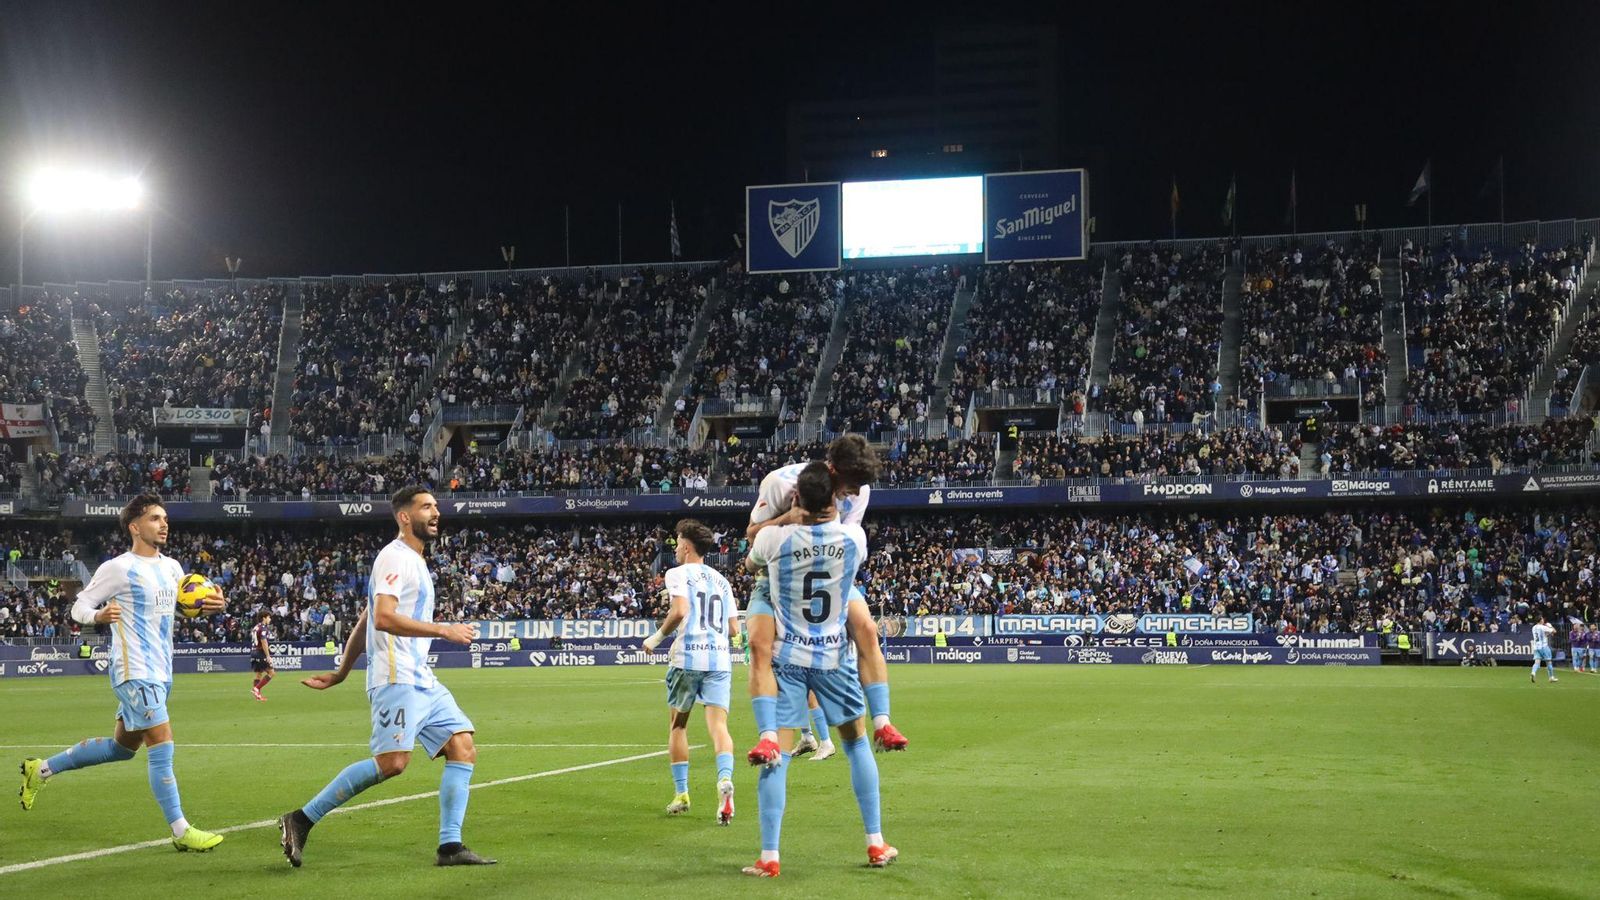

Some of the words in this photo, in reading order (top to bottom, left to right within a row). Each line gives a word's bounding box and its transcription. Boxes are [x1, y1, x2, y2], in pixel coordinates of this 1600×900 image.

[177, 409, 201, 419] LOS
[203, 409, 231, 419] 300
[1349, 480, 1390, 491] Málaga
[1441, 479, 1494, 488] RÉNTAME
[947, 491, 973, 499] divina
[975, 490, 1003, 498] events
[1255, 486, 1281, 495] Málaga
[1281, 486, 1306, 494] Wagen
[577, 499, 629, 508] SohoBoutique
[700, 498, 733, 507] Halcón
[793, 544, 845, 561] PASTOR
[802, 571, 831, 624] 5
[696, 591, 723, 634] 10
[488, 621, 516, 639] DE
[524, 621, 554, 639] UN
[561, 620, 649, 639] ESCUDO
[915, 616, 974, 636] 1904
[1145, 617, 1249, 631] HINCHAS
[1299, 635, 1364, 648] hummel
[288, 643, 343, 655] humml
[1155, 651, 1188, 659] CUEVA
[549, 652, 595, 665] vithas
[615, 651, 672, 664] SanMigue
[18, 665, 37, 674] MGS
[138, 684, 159, 706] 11
[394, 708, 406, 729] 4
